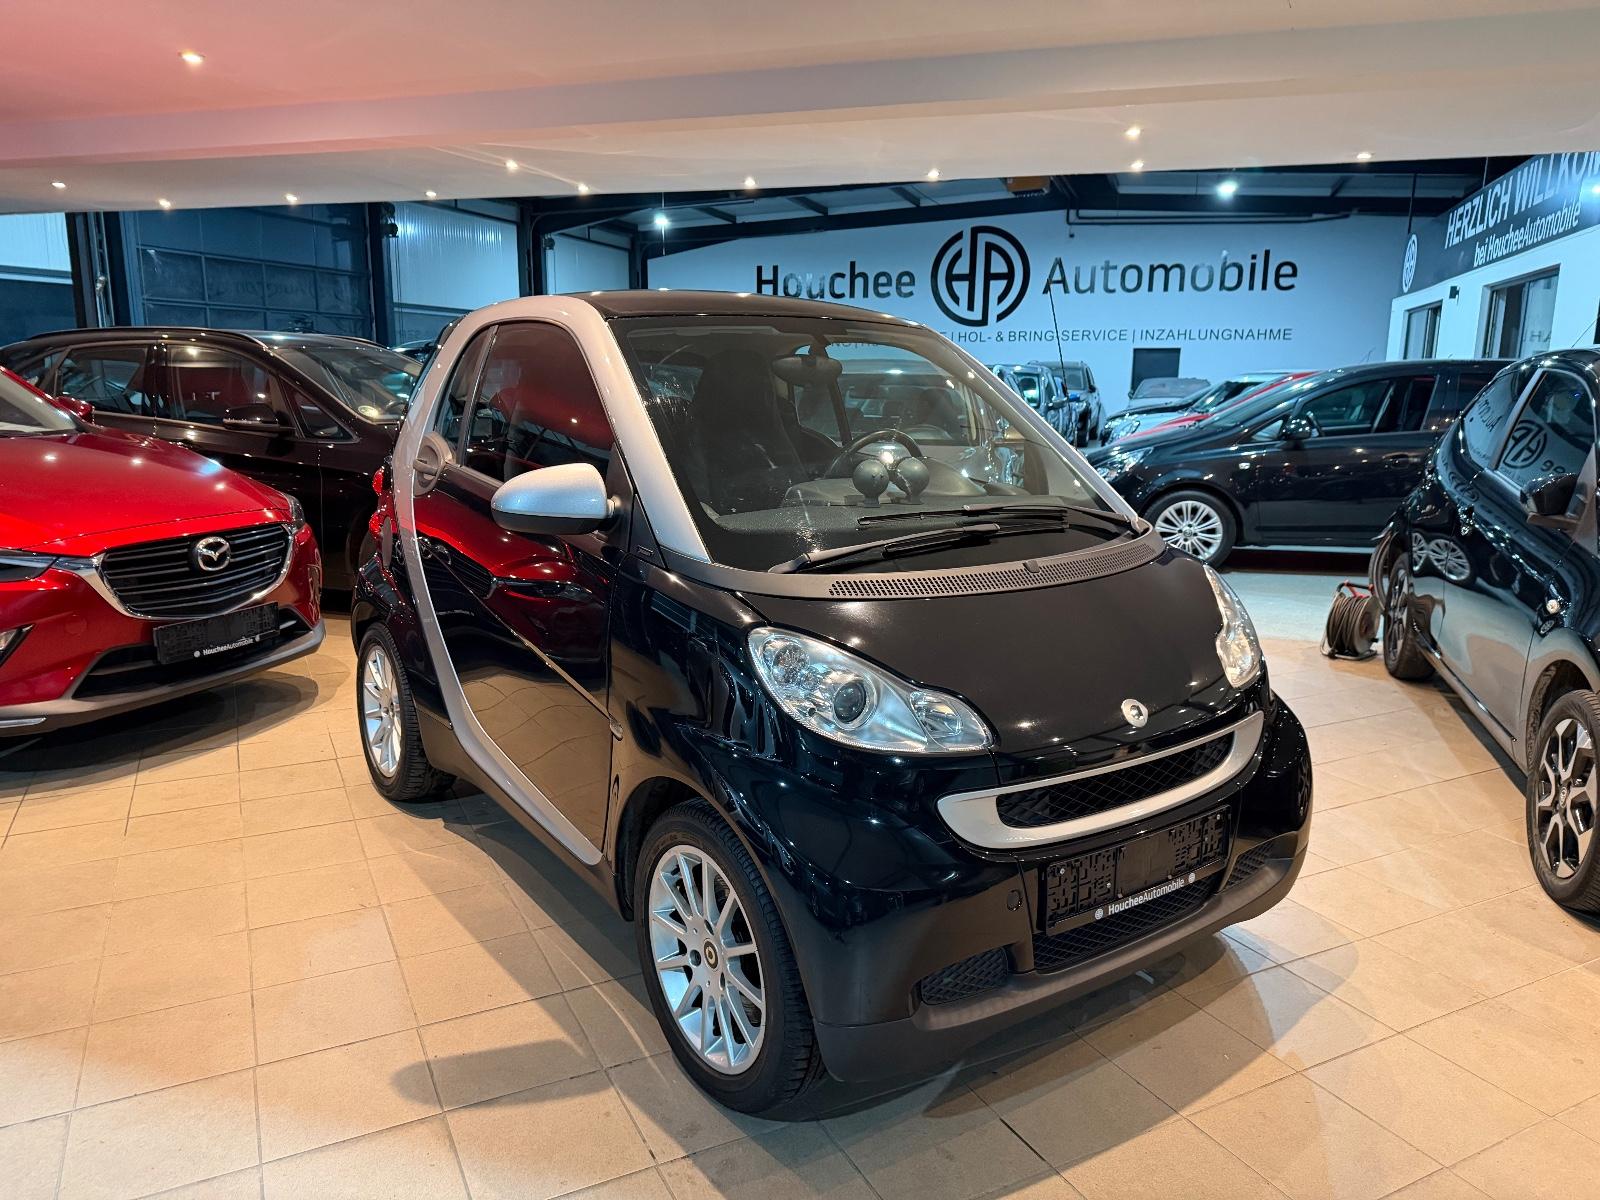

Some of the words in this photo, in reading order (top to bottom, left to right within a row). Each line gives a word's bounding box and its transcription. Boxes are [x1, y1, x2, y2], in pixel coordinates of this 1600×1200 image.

[1445, 175, 1513, 249] HERZLICH
[1473, 238, 1489, 267] bei
[757, 261, 916, 299] Houchee
[1042, 249, 1298, 294] Automobile
[995, 330, 1004, 342] &
[1140, 328, 1293, 341] INZAHLUNGNAHME
[1108, 877, 1185, 915] HoucheeAutomobile
